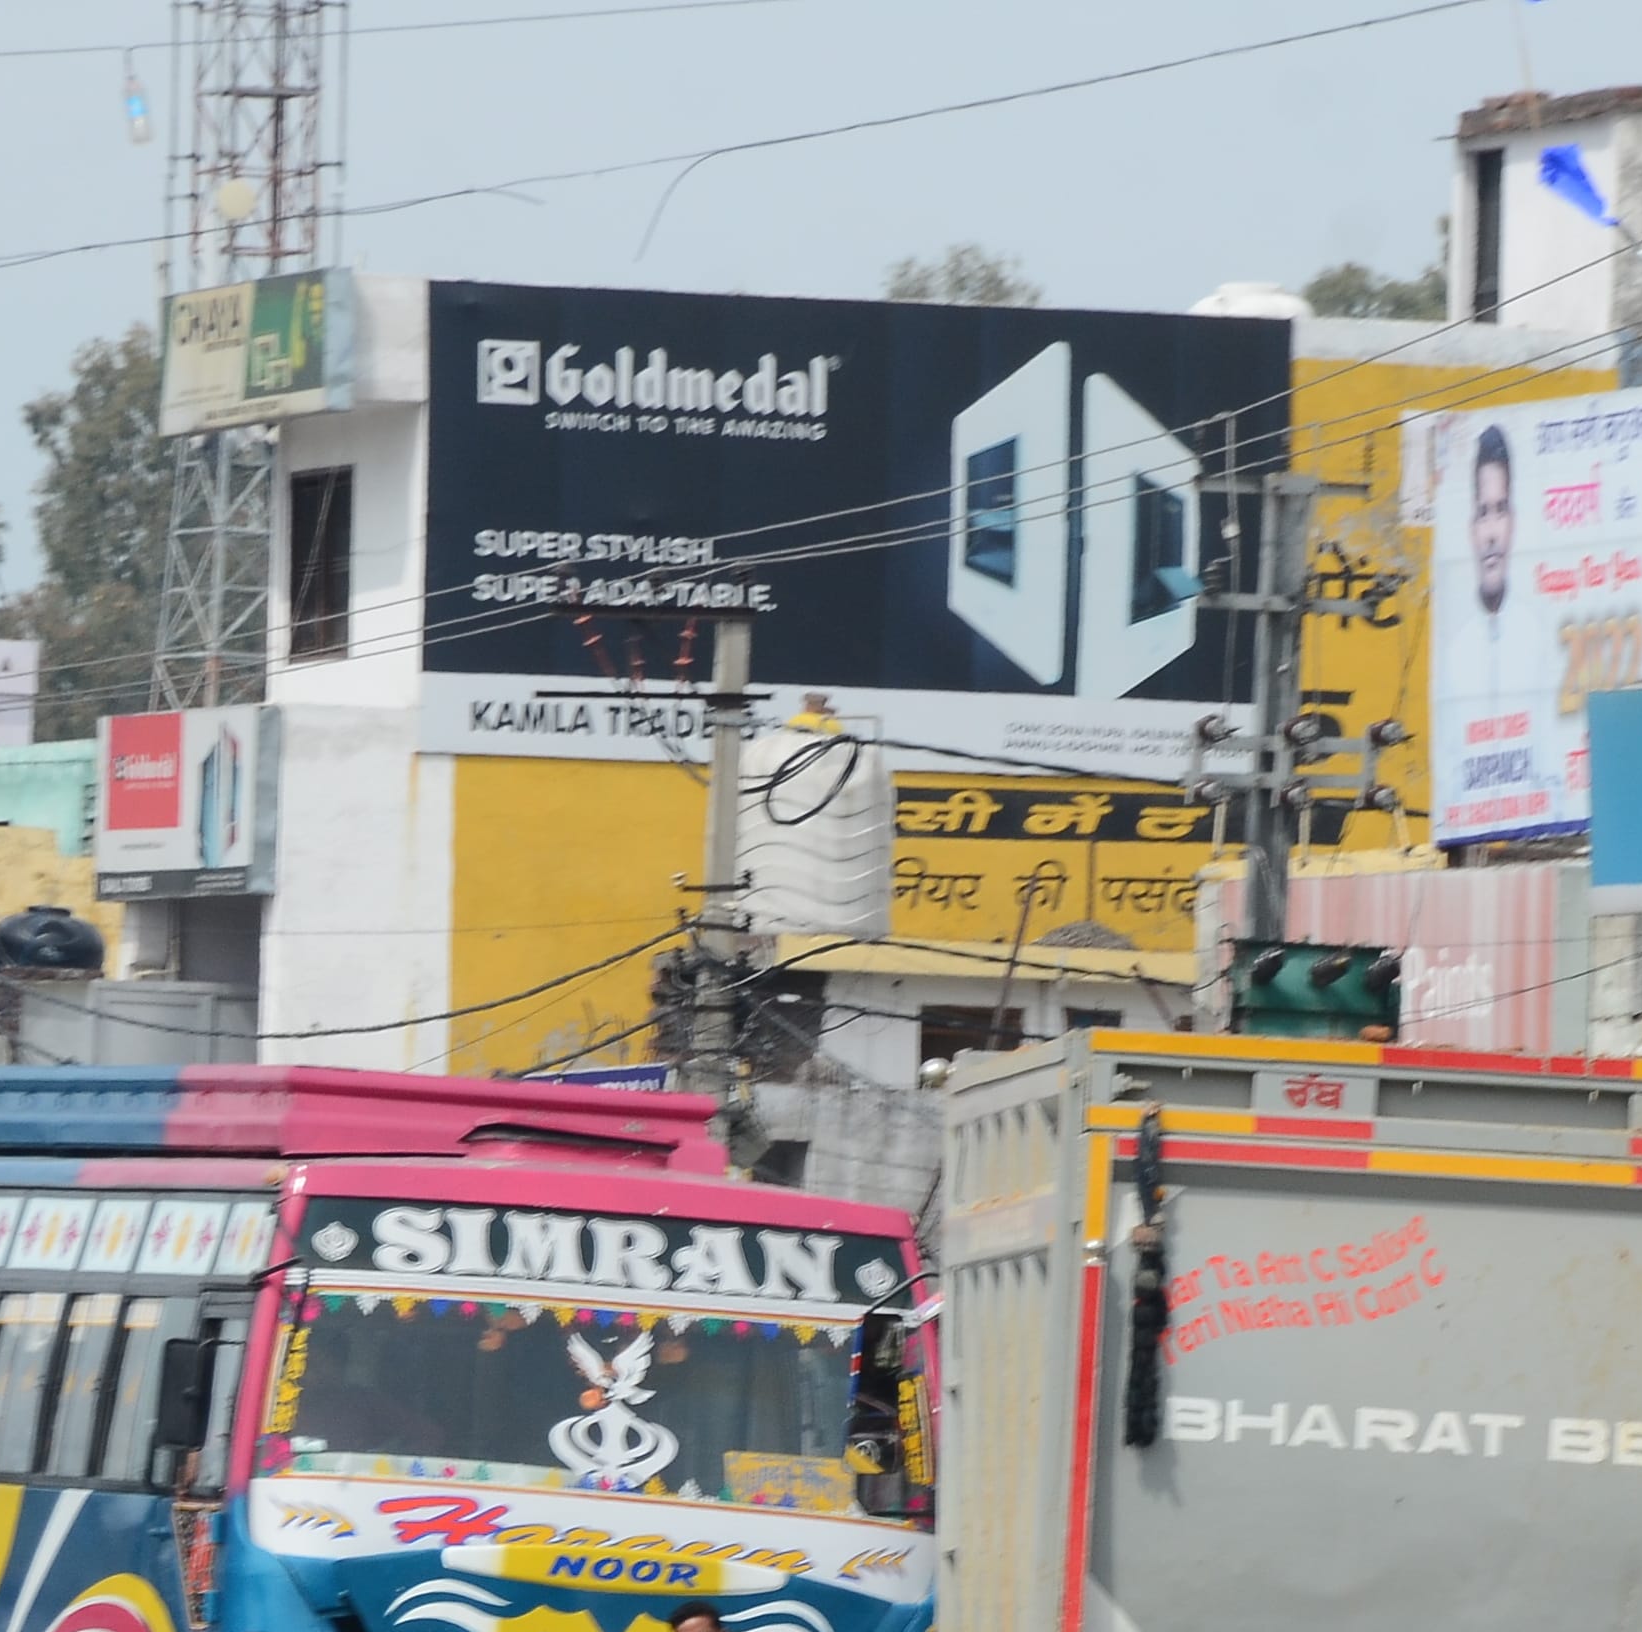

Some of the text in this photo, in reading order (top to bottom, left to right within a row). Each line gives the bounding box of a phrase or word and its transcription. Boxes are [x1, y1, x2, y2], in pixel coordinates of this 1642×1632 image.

[545, 343, 830, 418] Goldmedal
[545, 411, 828, 442] SWITCH TO THE AMAZING
[472, 528, 583, 560] SUPER
[470, 701, 594, 736] KAMLA
[371, 1206, 844, 1302] SIMRAN
[1165, 1396, 1525, 1458] BHARAT
[548, 1555, 702, 1587] NOOR
